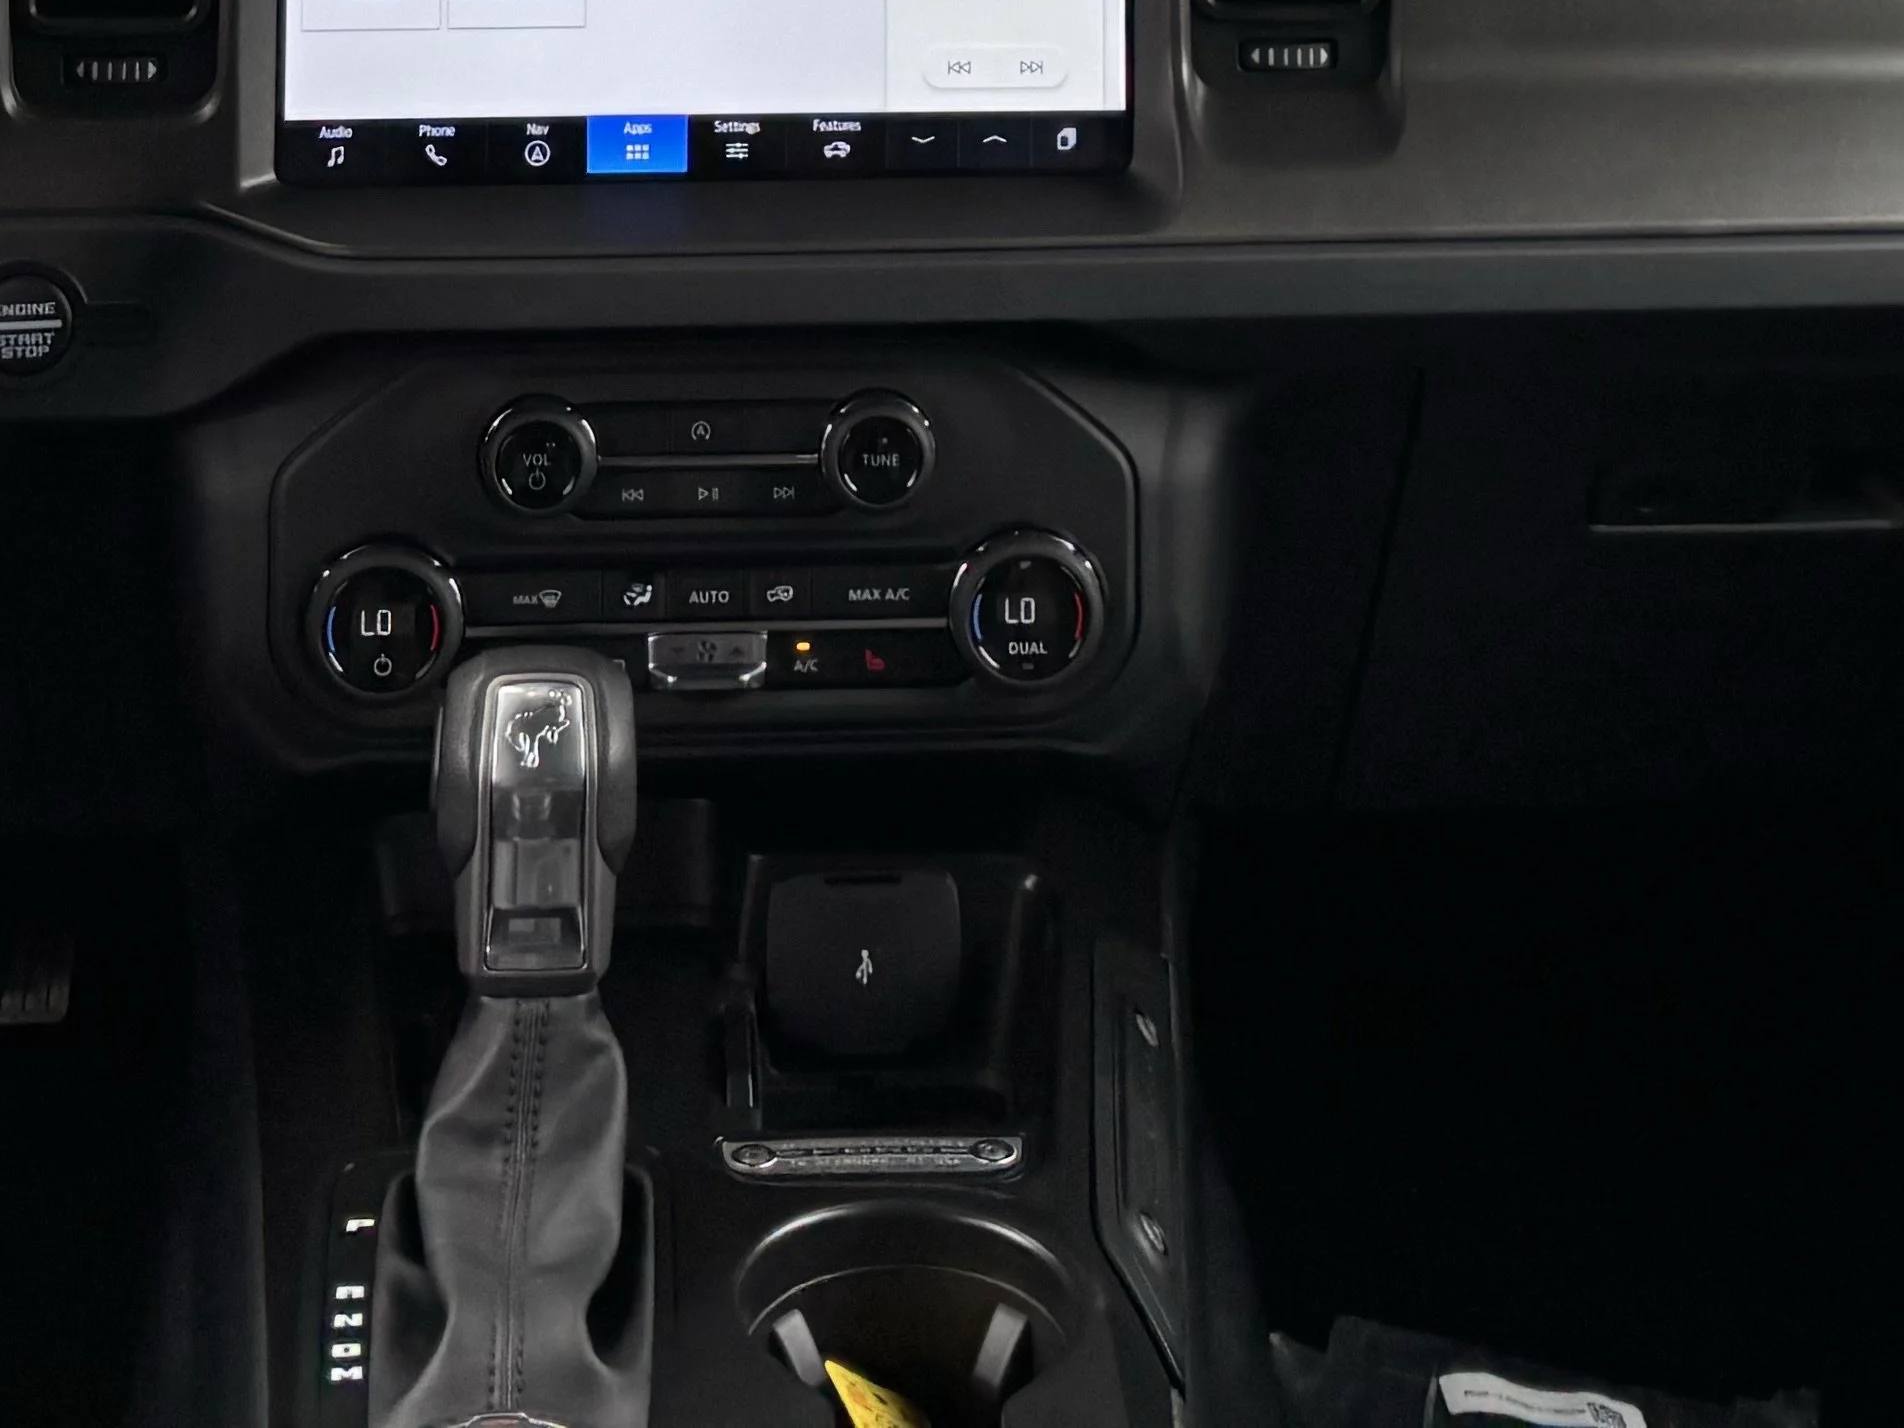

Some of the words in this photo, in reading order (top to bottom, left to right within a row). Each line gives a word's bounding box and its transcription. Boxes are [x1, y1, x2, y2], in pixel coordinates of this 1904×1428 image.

[318, 125, 353, 139] Audio
[418, 124, 456, 138] Phone
[526, 123, 550, 136] Nav
[623, 121, 653, 136] Apps
[714, 120, 761, 135] Settings
[812, 118, 862, 133] Features
[0, 345, 50, 360] STOP
[522, 452, 551, 468] VOL
[862, 453, 900, 468] TUNE
[512, 594, 538, 606] MAX
[689, 590, 730, 605] AUTO
[848, 588, 881, 602] MAX
[885, 588, 911, 601] A/C
[1008, 641, 1048, 655] DUAL
[793, 658, 819, 673] A/C
